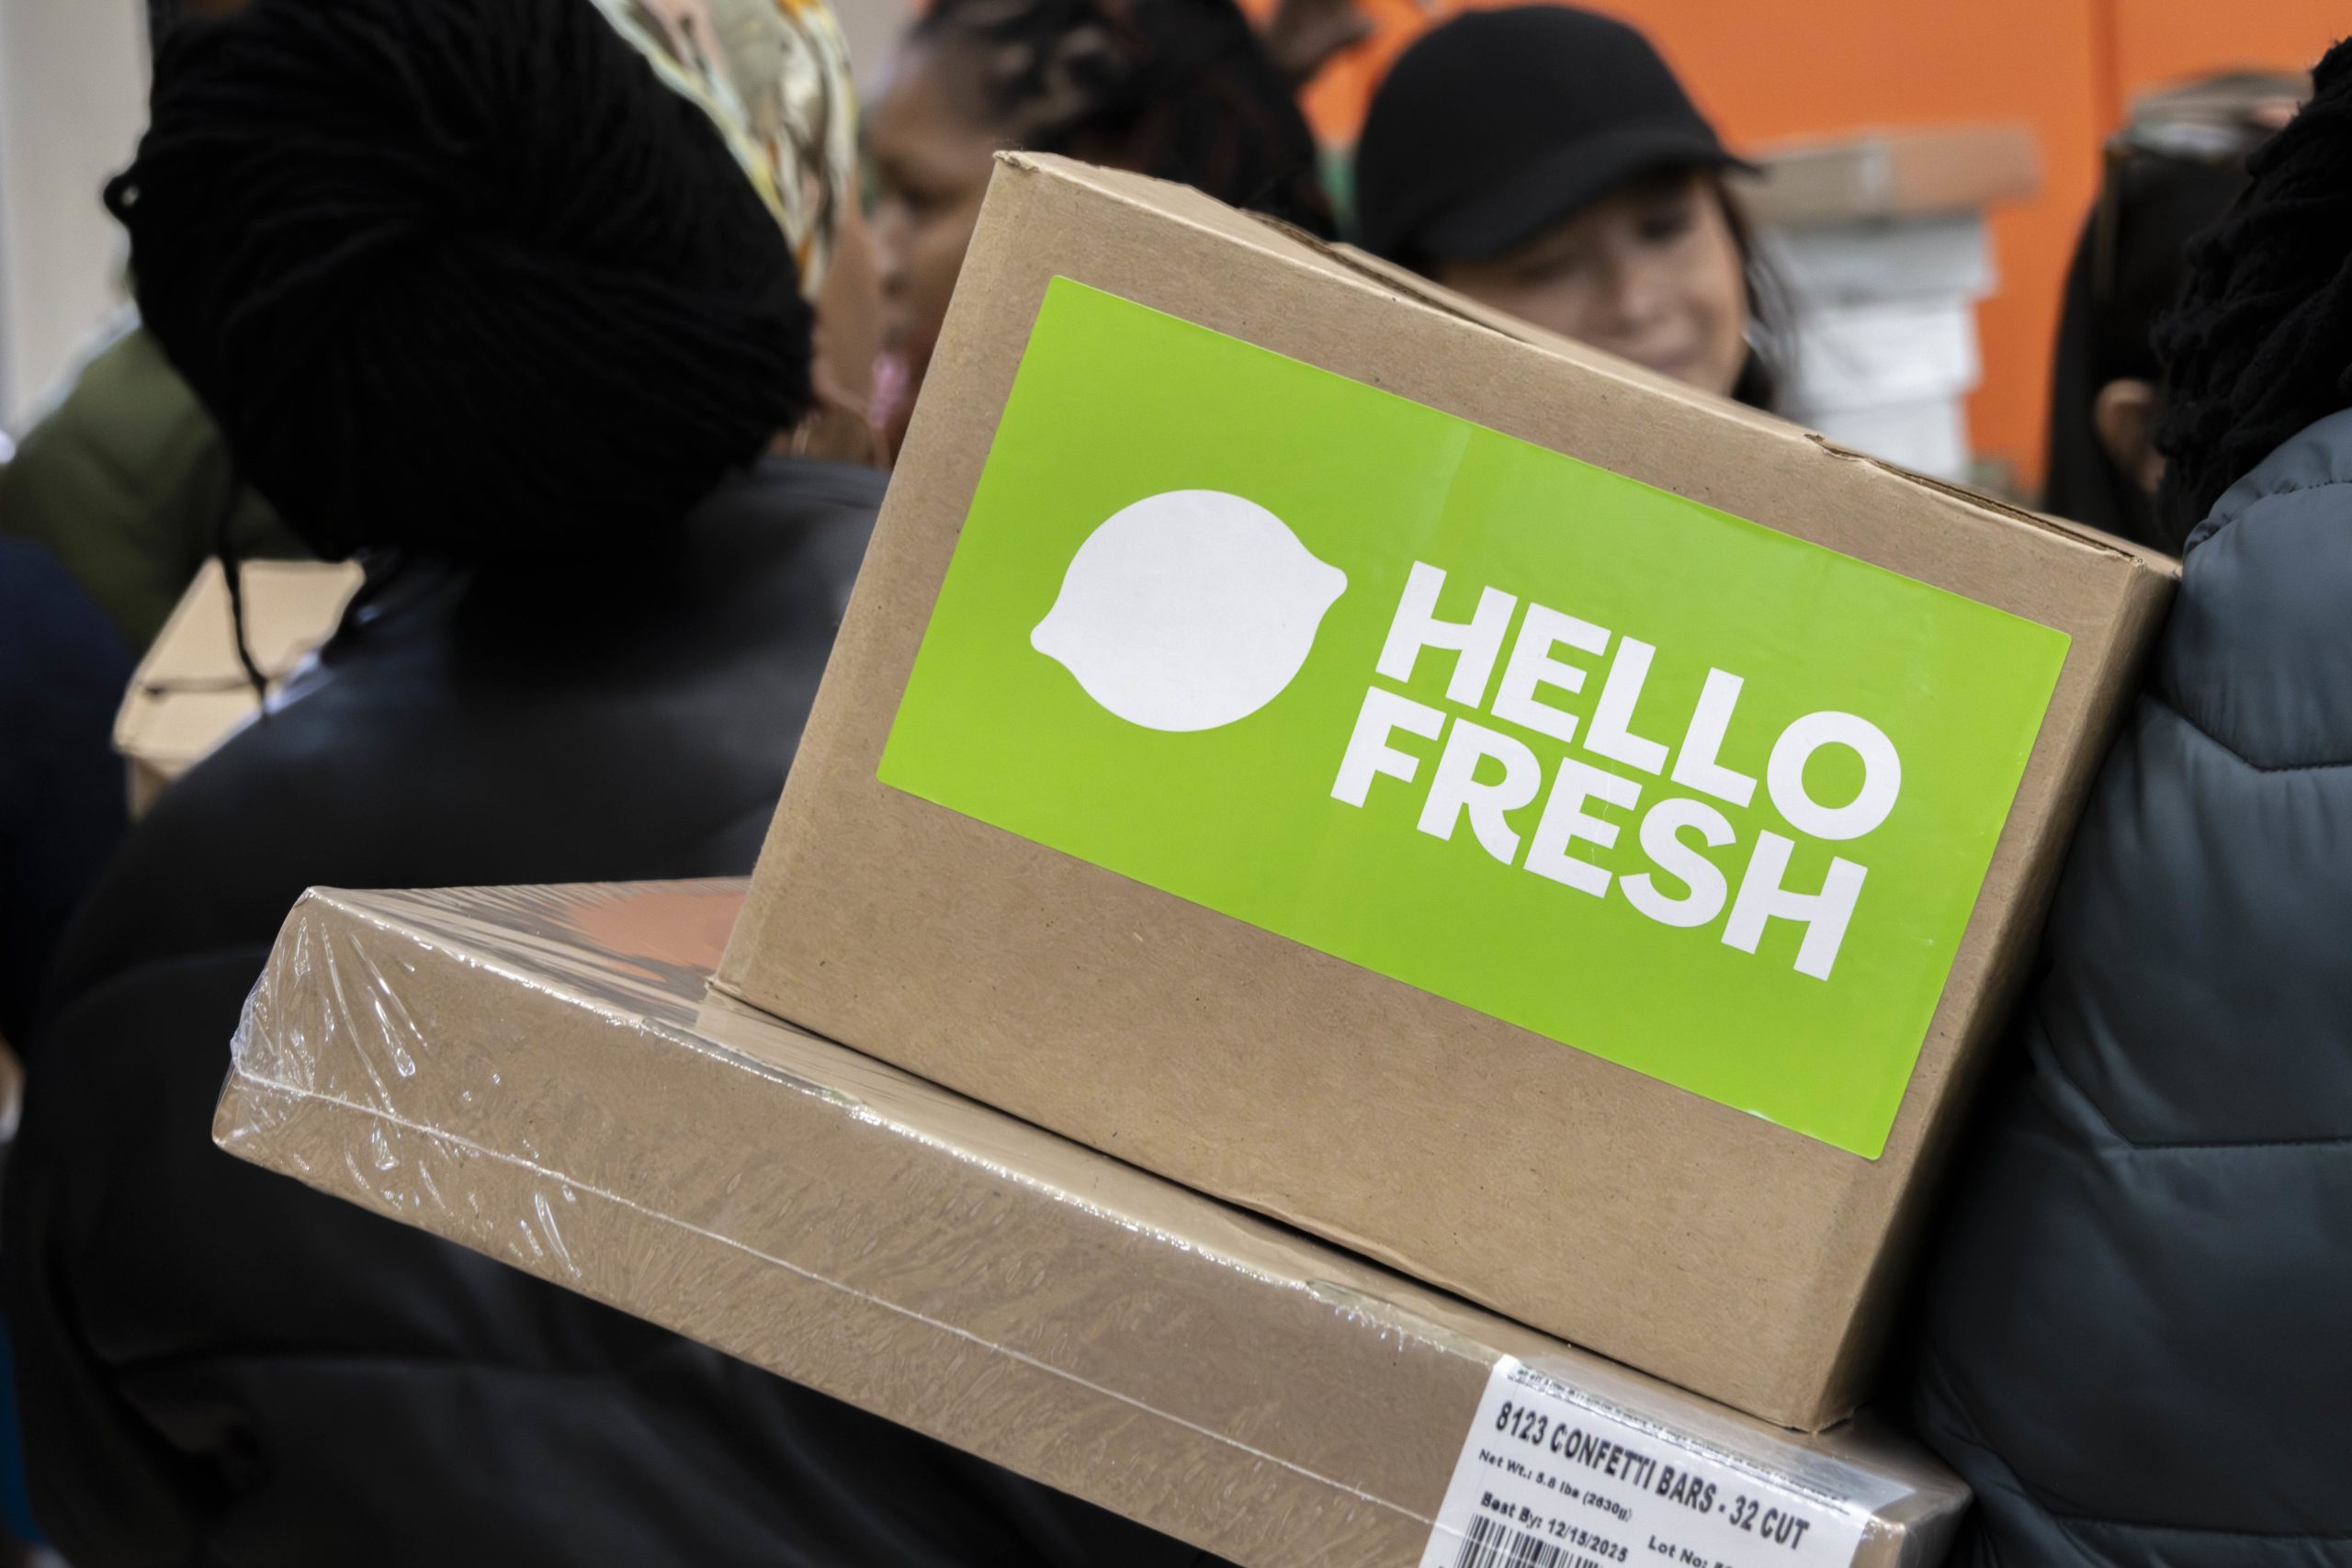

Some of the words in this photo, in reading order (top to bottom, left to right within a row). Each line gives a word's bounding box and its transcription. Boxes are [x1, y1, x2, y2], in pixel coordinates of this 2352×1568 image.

[1375, 560, 1902, 840] HELLO
[1330, 685, 1868, 982] FRESH
[1479, 1449, 1504, 1468] Net
[1559, 1481, 1579, 1499] lbs
[1480, 1491, 1516, 1517] Best
[1518, 1506, 1543, 1529] By:
[1547, 1517, 1629, 1562] 12/15/2025
[1495, 1401, 1548, 1446] 8123
[1549, 1423, 1657, 1490] CONFETTI
[1656, 1465, 1716, 1514] BARS
[1729, 1495, 1759, 1531] 32
[1759, 1506, 1810, 1551] CUT
[1647, 1535, 1676, 1557] Lot
[1679, 1548, 1708, 1568] No:
